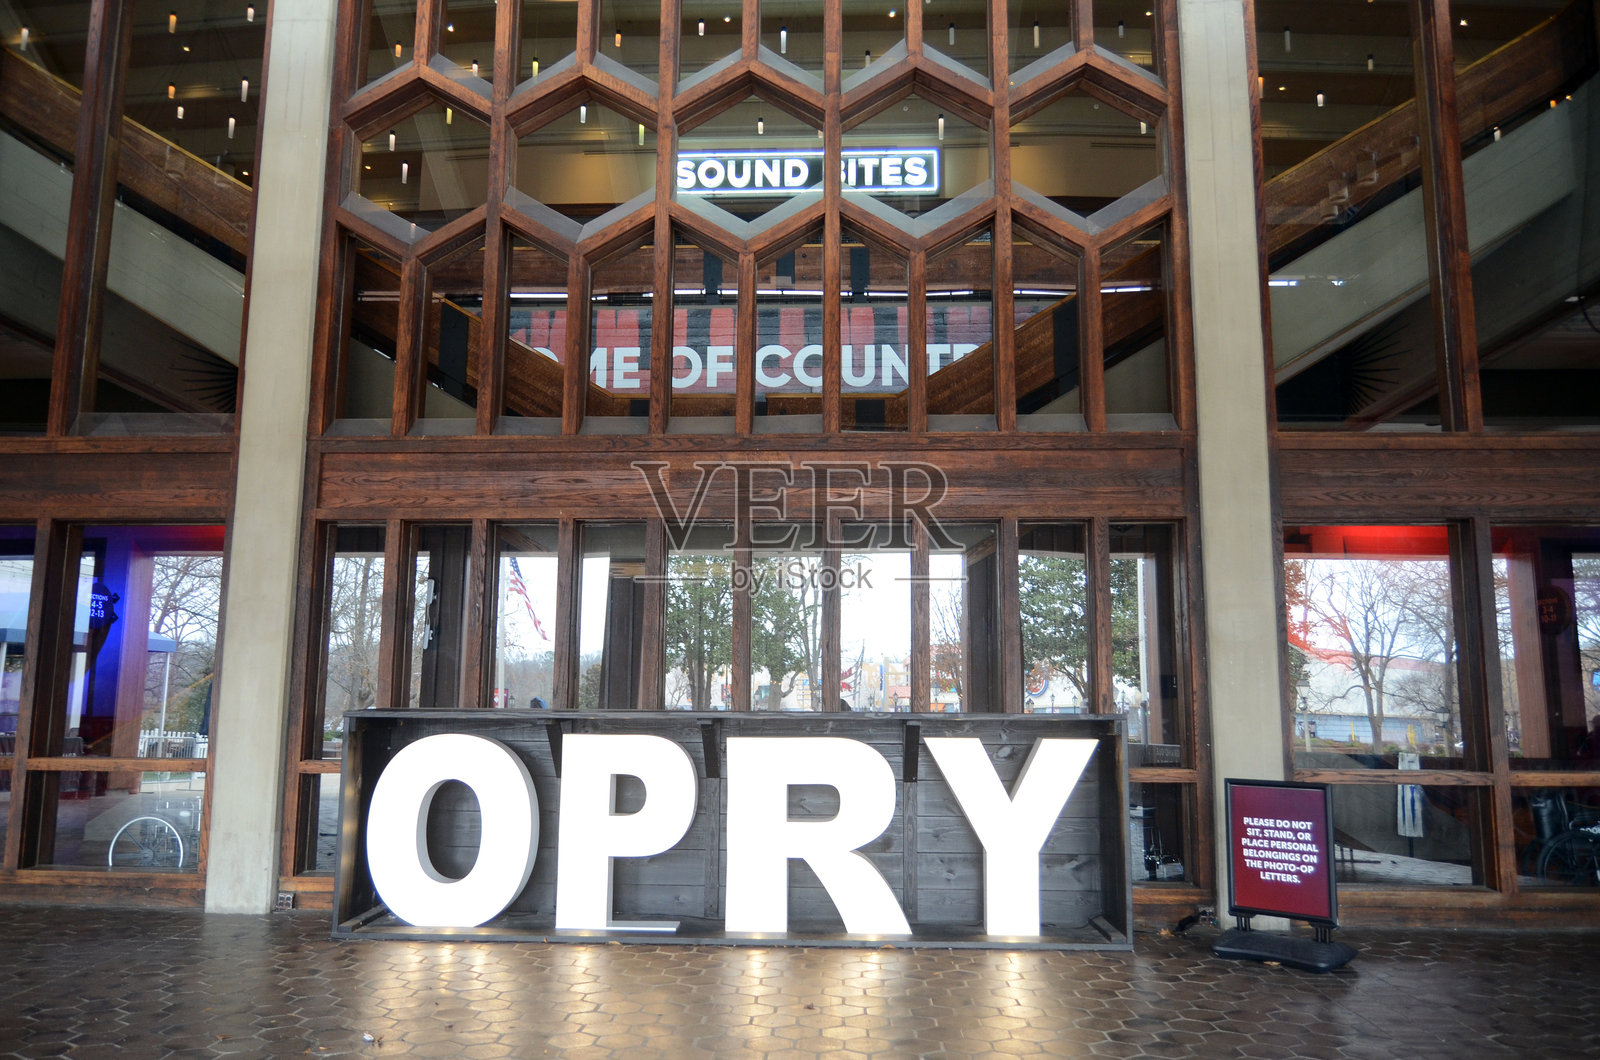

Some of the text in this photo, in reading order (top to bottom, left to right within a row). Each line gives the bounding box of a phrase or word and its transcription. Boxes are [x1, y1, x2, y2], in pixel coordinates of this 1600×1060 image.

[677, 157, 928, 189] SOUND ITES
[672, 346, 734, 388] OF
[755, 344, 980, 388] COUNT
[1243, 816, 1312, 830] PLEASE DO NOT
[366, 733, 1100, 936] OPRY
[1246, 827, 1311, 841] SIT, STAND, OR
[1241, 837, 1319, 852] PLACE PERSONAL
[1243, 848, 1317, 863] BELONGINGS ON
[1244, 858, 1314, 873] THE PHOTO-OP
[1260, 871, 1301, 883] LETTERS.
